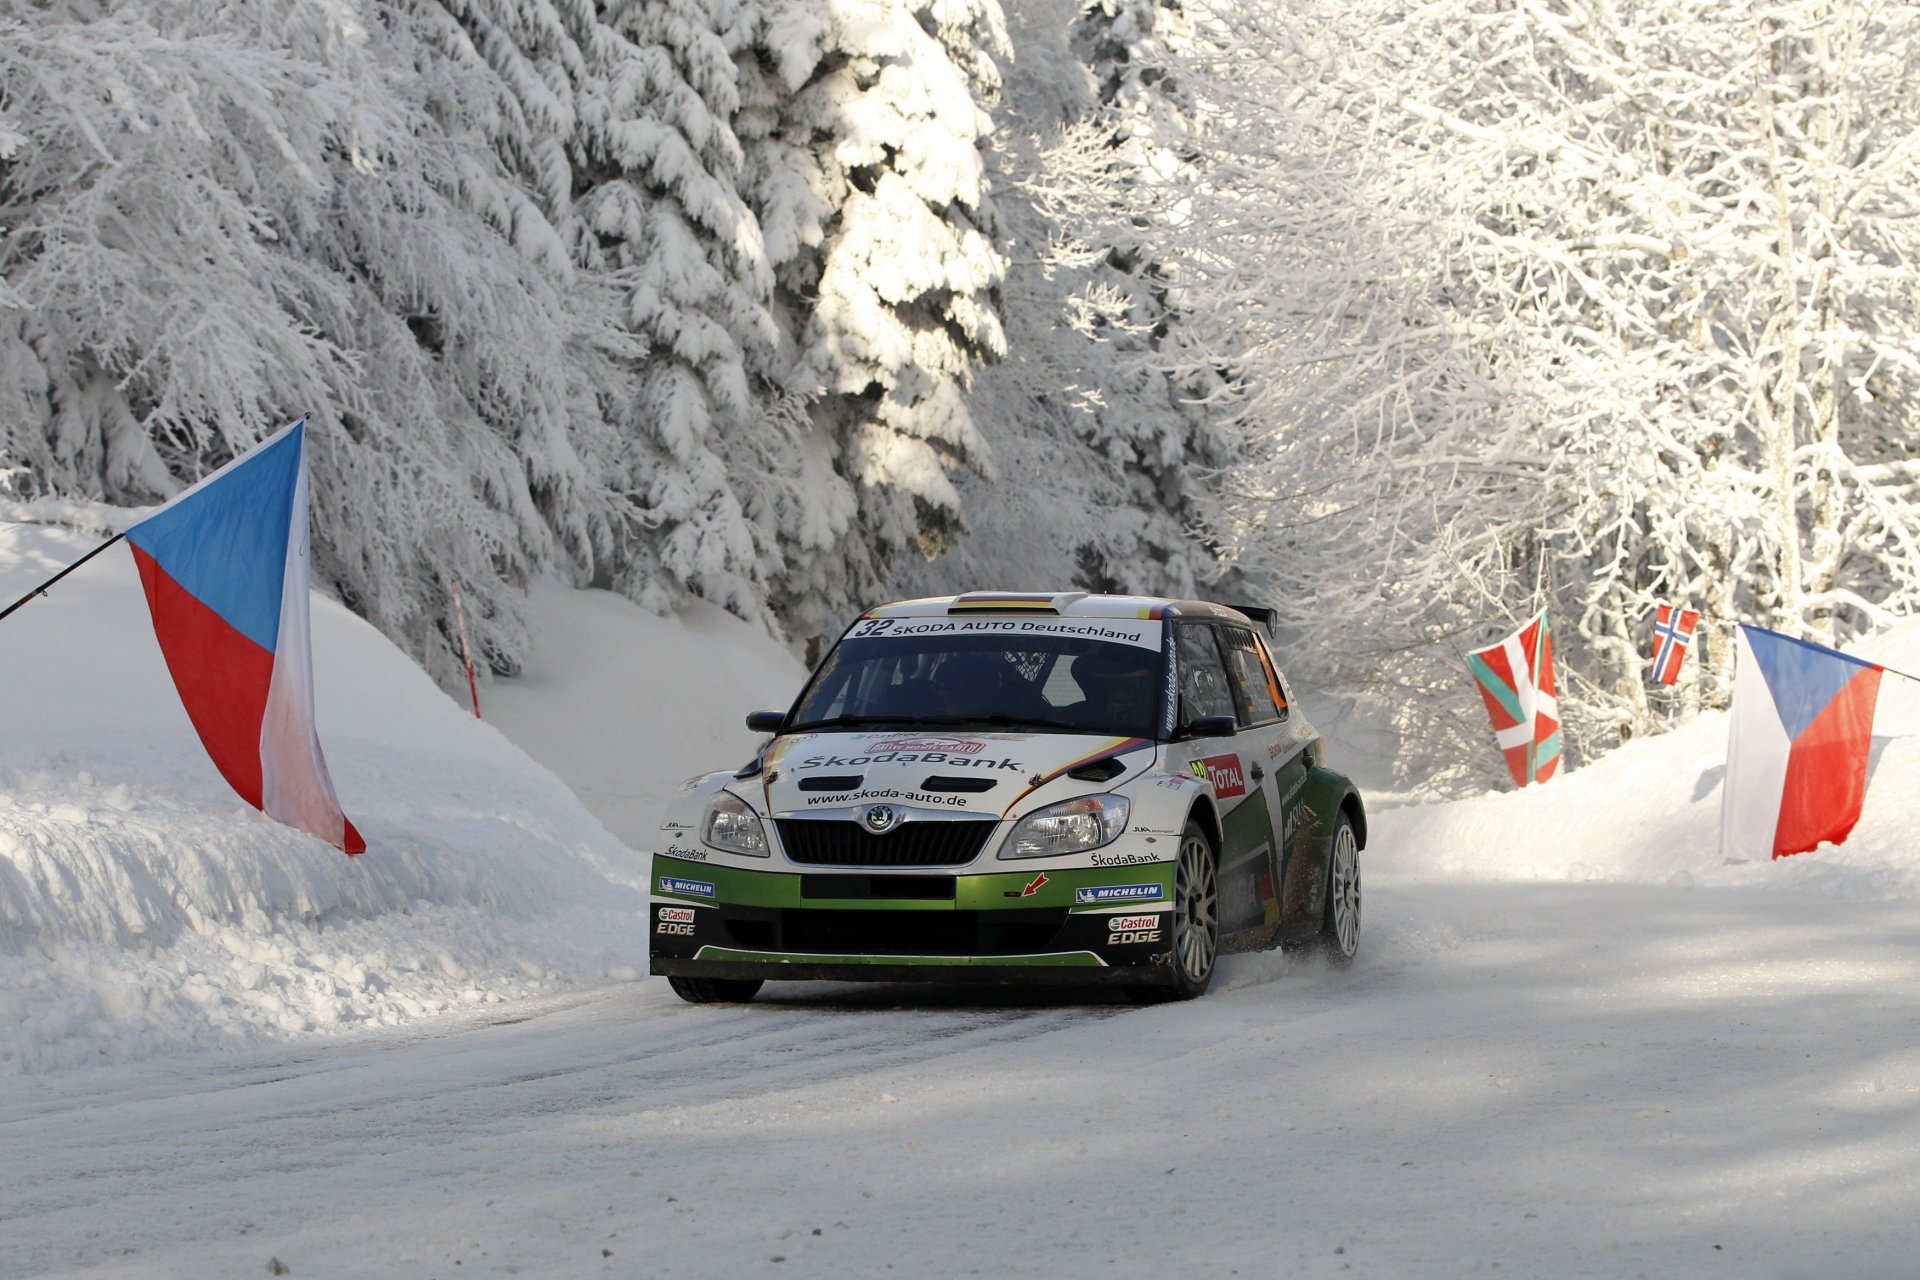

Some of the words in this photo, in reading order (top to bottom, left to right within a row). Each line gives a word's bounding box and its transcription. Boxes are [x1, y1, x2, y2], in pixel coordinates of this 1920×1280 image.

[856, 619, 894, 637] 32
[958, 621, 1016, 631] AUTO
[1020, 622, 1142, 642] Deutschland
[1165, 636, 1177, 733] www.skoda-auto.de
[798, 752, 1024, 771] ŠkodaBank
[1207, 765, 1244, 790] TOTAL
[807, 788, 967, 807] www.skoda-auto.de
[1091, 852, 1160, 867] ŠkodaBank
[674, 881, 712, 893] MICHELIN
[1097, 886, 1158, 898] MICHELIN
[667, 909, 693, 921] Castrol
[656, 922, 696, 936] EDGE
[1120, 917, 1157, 930] Castrol
[1107, 930, 1163, 945] EDGE
